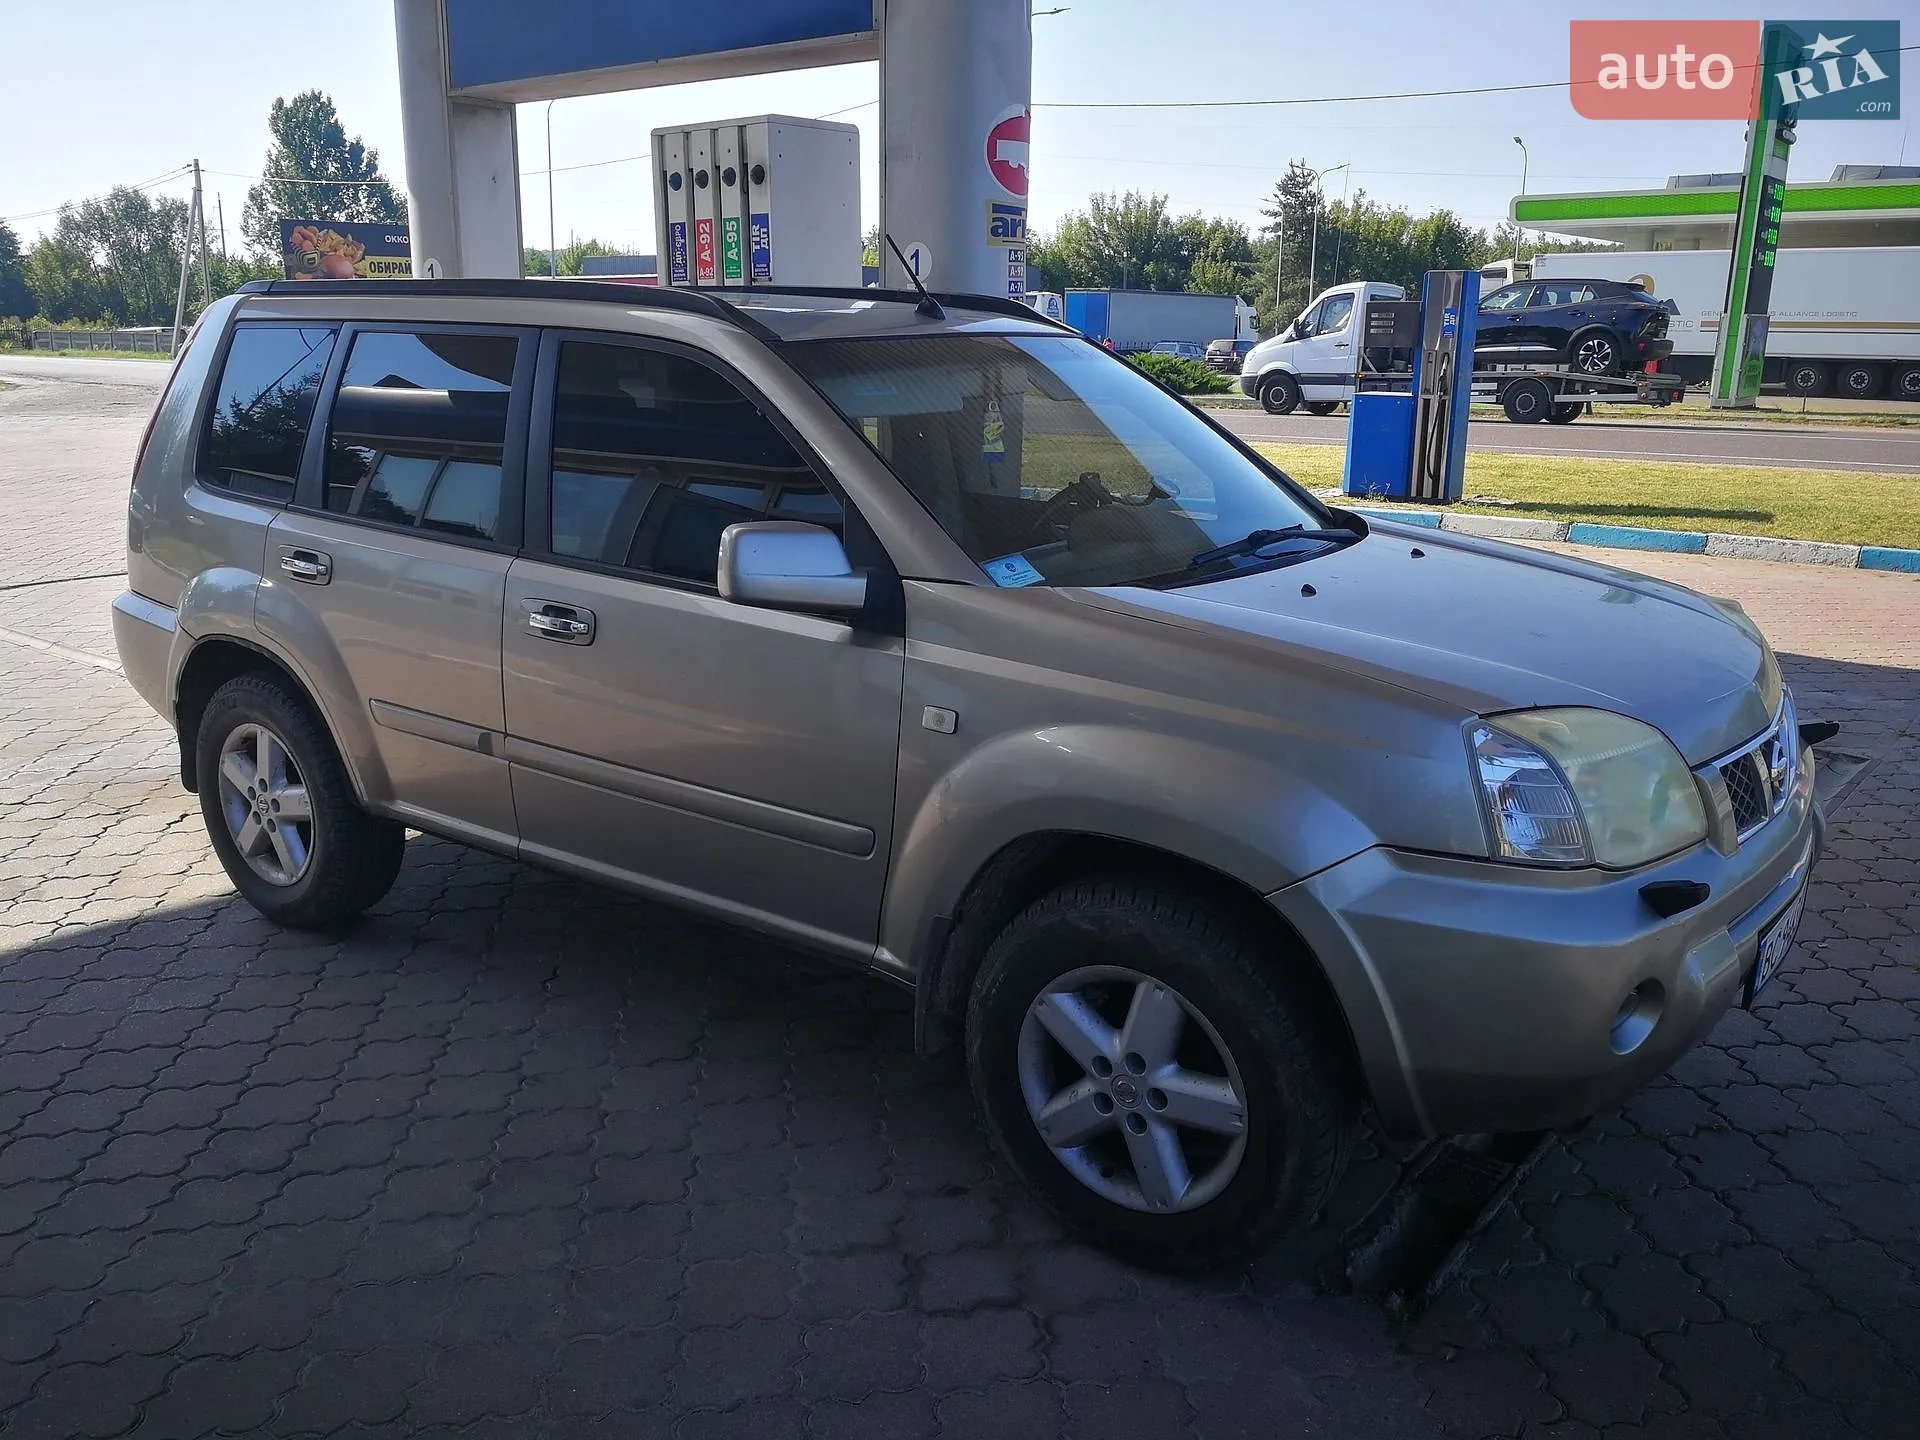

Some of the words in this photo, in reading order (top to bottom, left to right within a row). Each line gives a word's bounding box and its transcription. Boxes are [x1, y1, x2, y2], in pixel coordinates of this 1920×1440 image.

[752, 224, 760, 253] TIR
[369, 260, 412, 274] ОБИРАЙ
[428, 263, 434, 278] 1
[910, 248, 920, 277] 1
